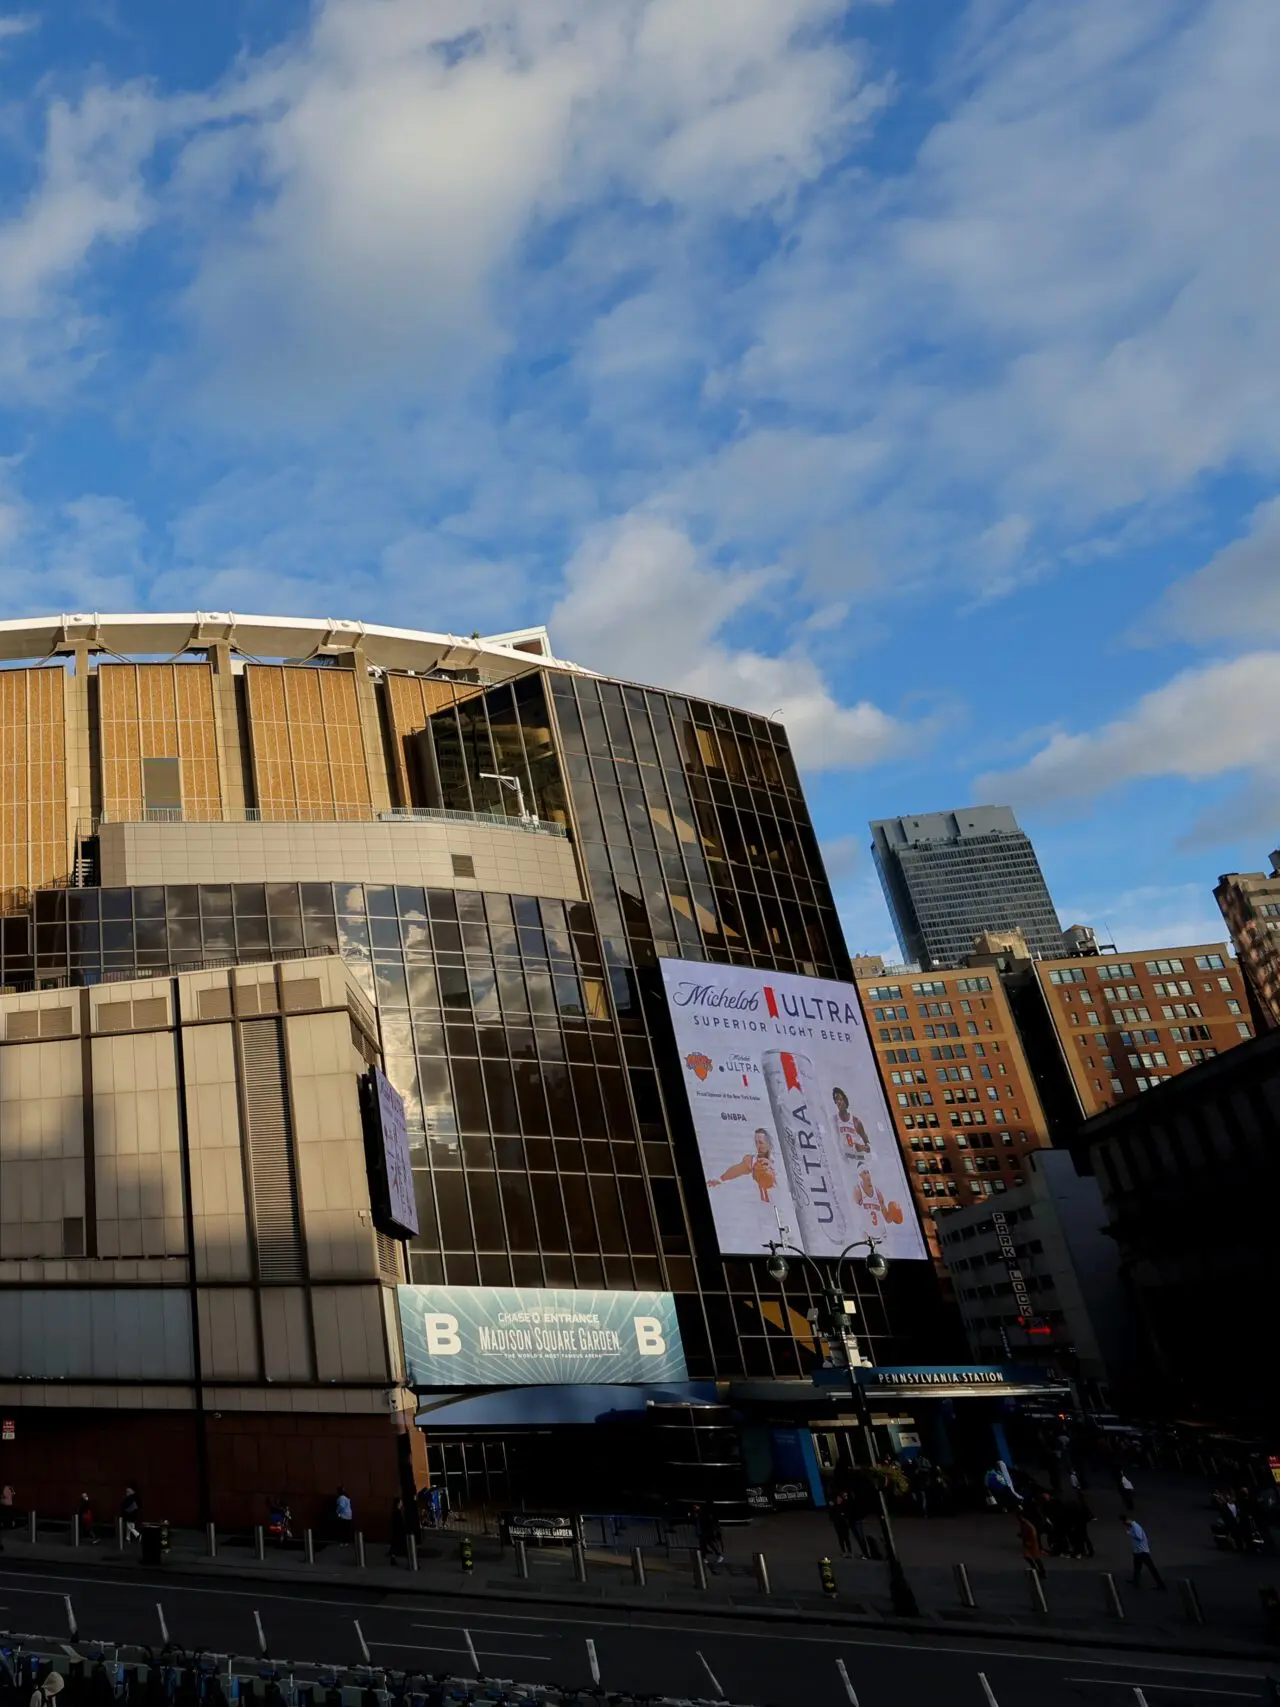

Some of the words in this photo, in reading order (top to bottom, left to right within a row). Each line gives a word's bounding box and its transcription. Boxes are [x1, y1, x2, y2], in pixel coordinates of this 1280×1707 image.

[673, 982, 760, 1012] Michelob
[781, 994, 859, 1026] ULTRA
[693, 1015, 768, 1032] SUPERIOR
[775, 1024, 813, 1039] LIGHT
[821, 1030, 852, 1043] BEER
[725, 1061, 760, 1073] ULTRA
[792, 1104, 833, 1223] ULTRA
[993, 1213, 1015, 1257] PARK
[1009, 1270, 1032, 1316] LOCK
[424, 1313, 462, 1355] B
[498, 1312, 531, 1324] CHASE
[543, 1313, 600, 1324] ENTRANCE
[478, 1326, 532, 1351] MADISON
[533, 1326, 575, 1353] SQUARE
[578, 1328, 621, 1351] GARDEN
[633, 1316, 666, 1356] B
[878, 1373, 959, 1384] PENNSYLVANIA
[962, 1372, 1004, 1383] STATION
